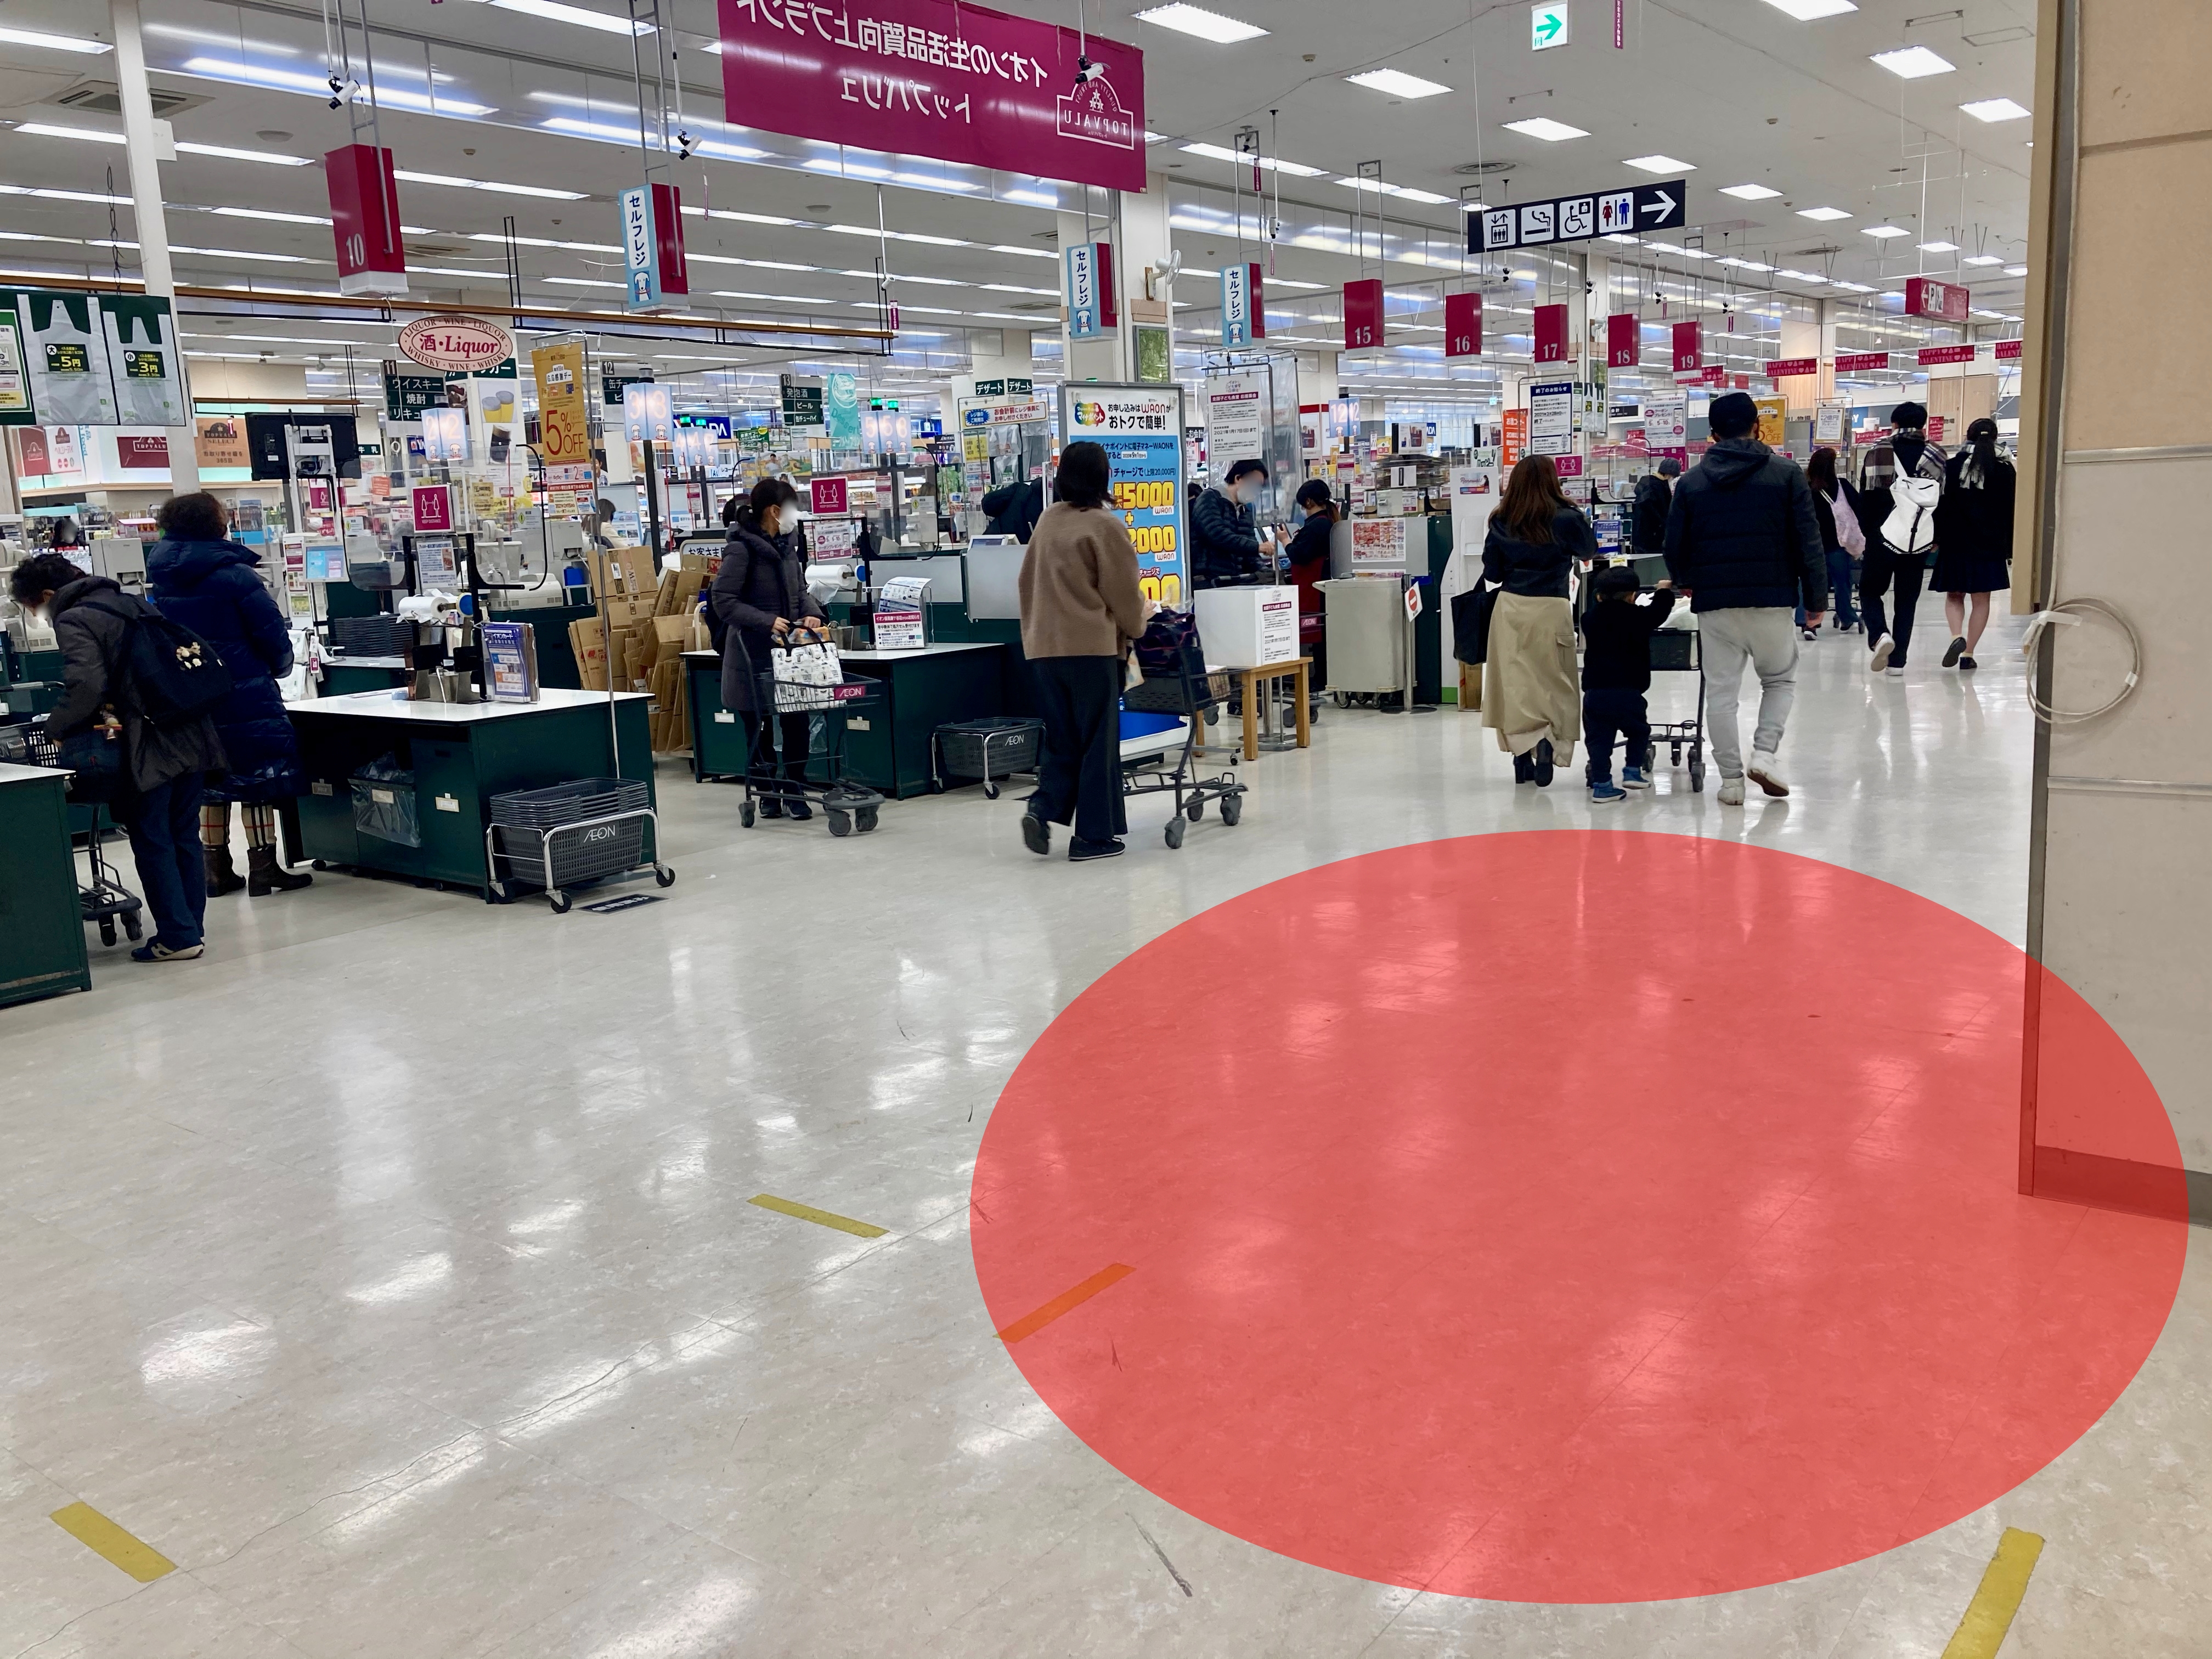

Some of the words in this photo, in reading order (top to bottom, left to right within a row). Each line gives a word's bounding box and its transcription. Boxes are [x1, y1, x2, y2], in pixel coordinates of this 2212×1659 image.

[629, 195, 646, 266] セルフレジ
[346, 233, 364, 268] 10
[1076, 251, 1088, 305] セルフレジ
[1229, 270, 1240, 319] セルフレジ
[405, 319, 437, 338] LIQUOR
[443, 317, 466, 325] WINE
[473, 320, 506, 342] LIQUOR
[1355, 326, 1371, 345] 15
[1455, 335, 1470, 352] 16
[1543, 343, 1558, 359] 17
[408, 346, 441, 368] WHISKY
[477, 350, 507, 368] WHISKY
[1616, 350, 1630, 364] 18
[1681, 355, 1694, 368] 19
[385, 360, 396, 375] 11
[603, 361, 614, 374] 12
[392, 377, 441, 390] ウイスキー
[783, 374, 790, 386] 13
[977, 382, 1003, 394] デザート
[1008, 381, 1031, 391] デザート
[406, 393, 426, 404] 焼酎
[1331, 403, 1348, 423] 12
[563, 433, 584, 454] OFF
